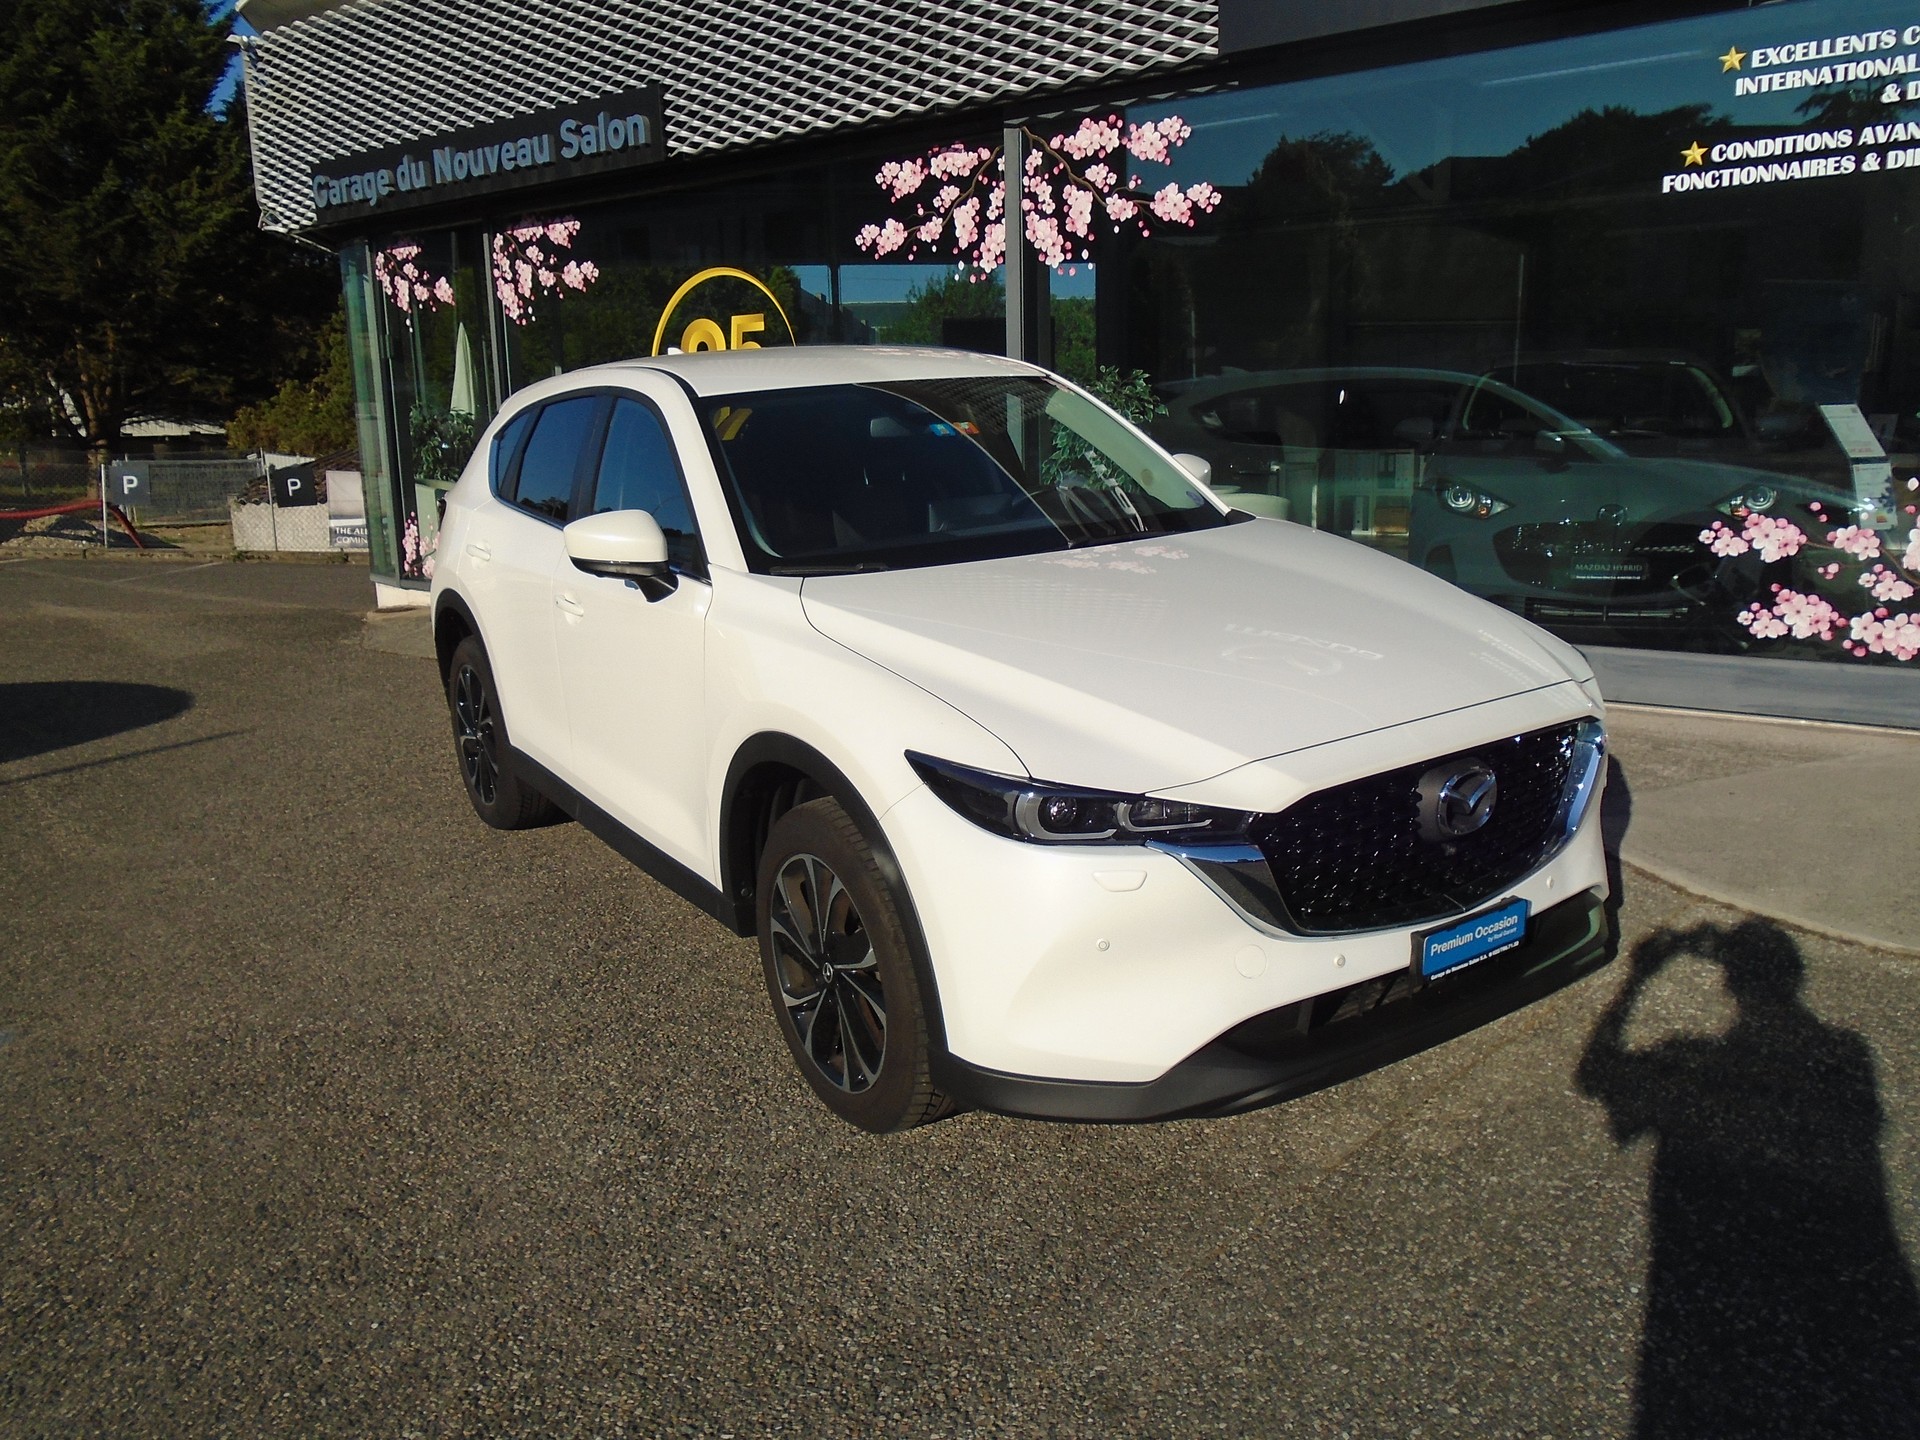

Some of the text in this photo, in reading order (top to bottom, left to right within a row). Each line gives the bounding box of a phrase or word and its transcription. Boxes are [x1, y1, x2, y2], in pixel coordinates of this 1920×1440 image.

[1751, 29, 1897, 69] EXCELLENTS
[1735, 53, 1920, 97] INTERNATIONAL
[1880, 83, 1902, 104] &
[313, 112, 648, 207] Garage du Nouveau Salon
[1710, 129, 1854, 163] CONDITIONS
[1662, 155, 1857, 194] FONCTIONNAIRES
[1861, 152, 1882, 173] &
[122, 475, 138, 495] P
[286, 478, 301, 497] P
[1430, 932, 1473, 957] Premium
[1475, 915, 1518, 939] Occasion
